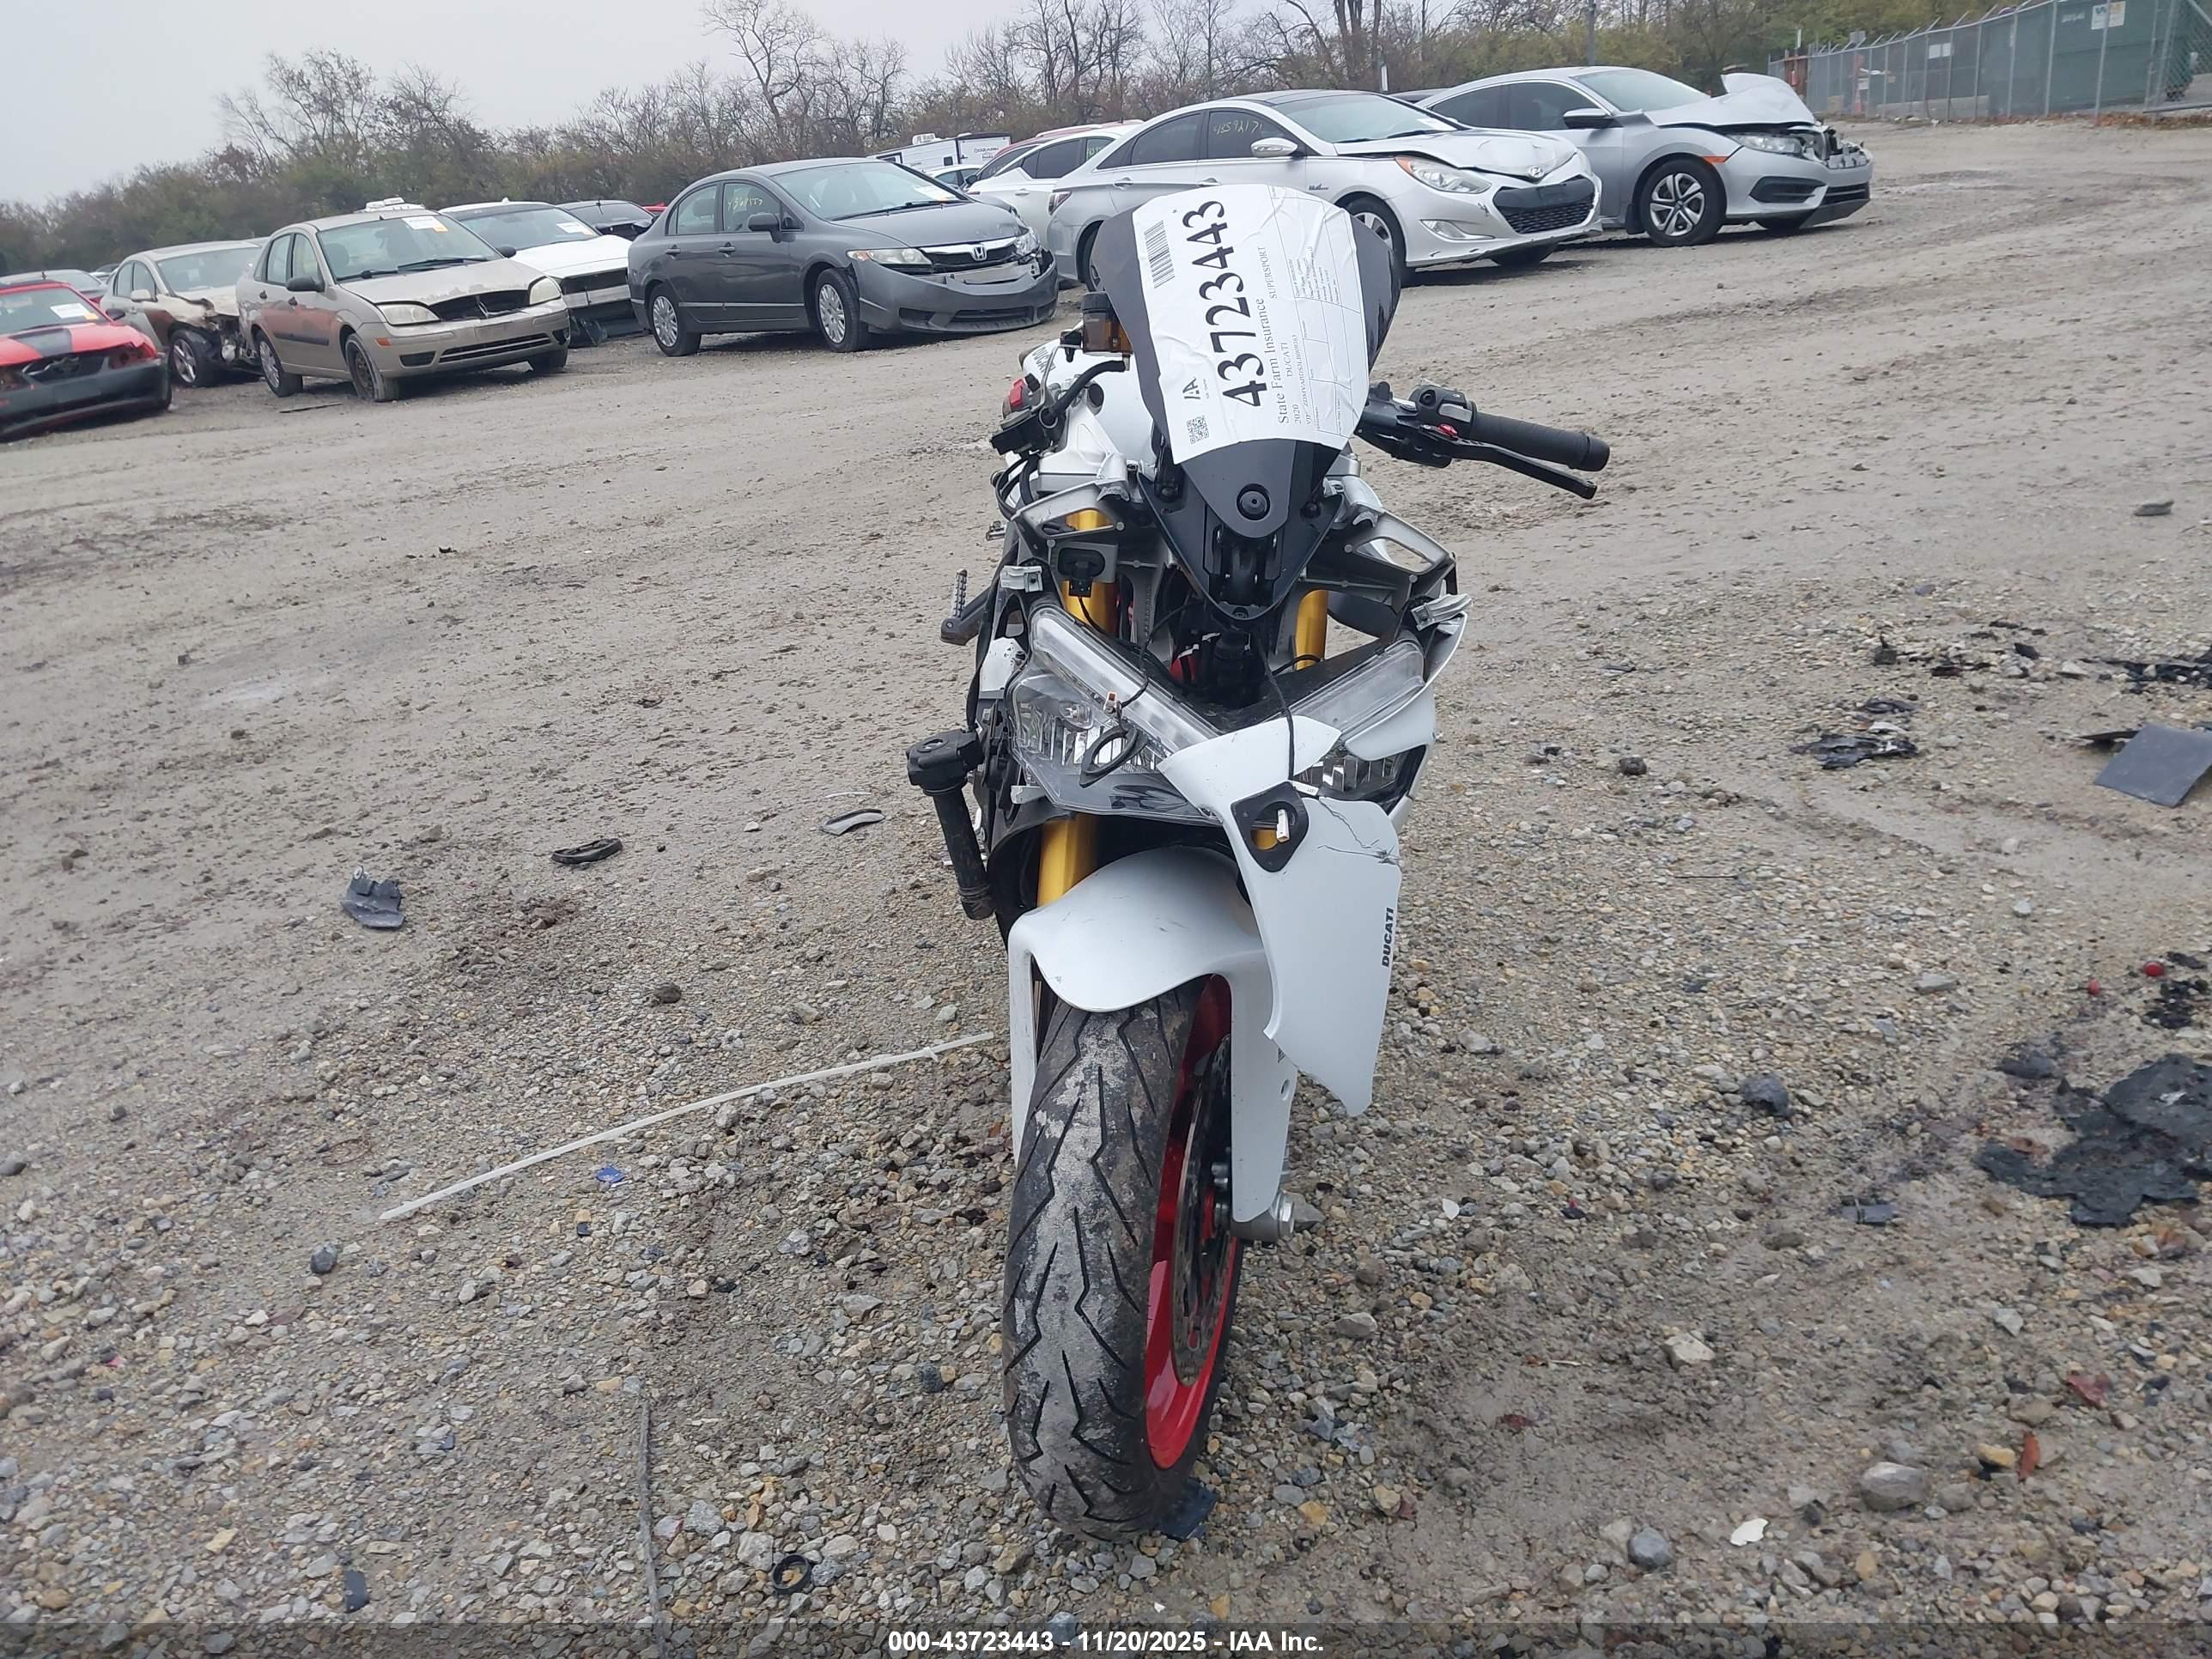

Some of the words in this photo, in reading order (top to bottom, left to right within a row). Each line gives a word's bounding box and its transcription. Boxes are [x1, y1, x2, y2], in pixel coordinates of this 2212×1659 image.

[1260, 246, 1278, 300] SUPERSPORT
[1182, 200, 1268, 407] 43723443
[1256, 299, 1276, 354] Insurance
[1270, 357, 1283, 390] Farm
[1281, 343, 1293, 378] DUCATI
[1277, 393, 1290, 424] State
[1291, 404, 1302, 425] 2020
[1381, 907, 1395, 968] DUCATI
